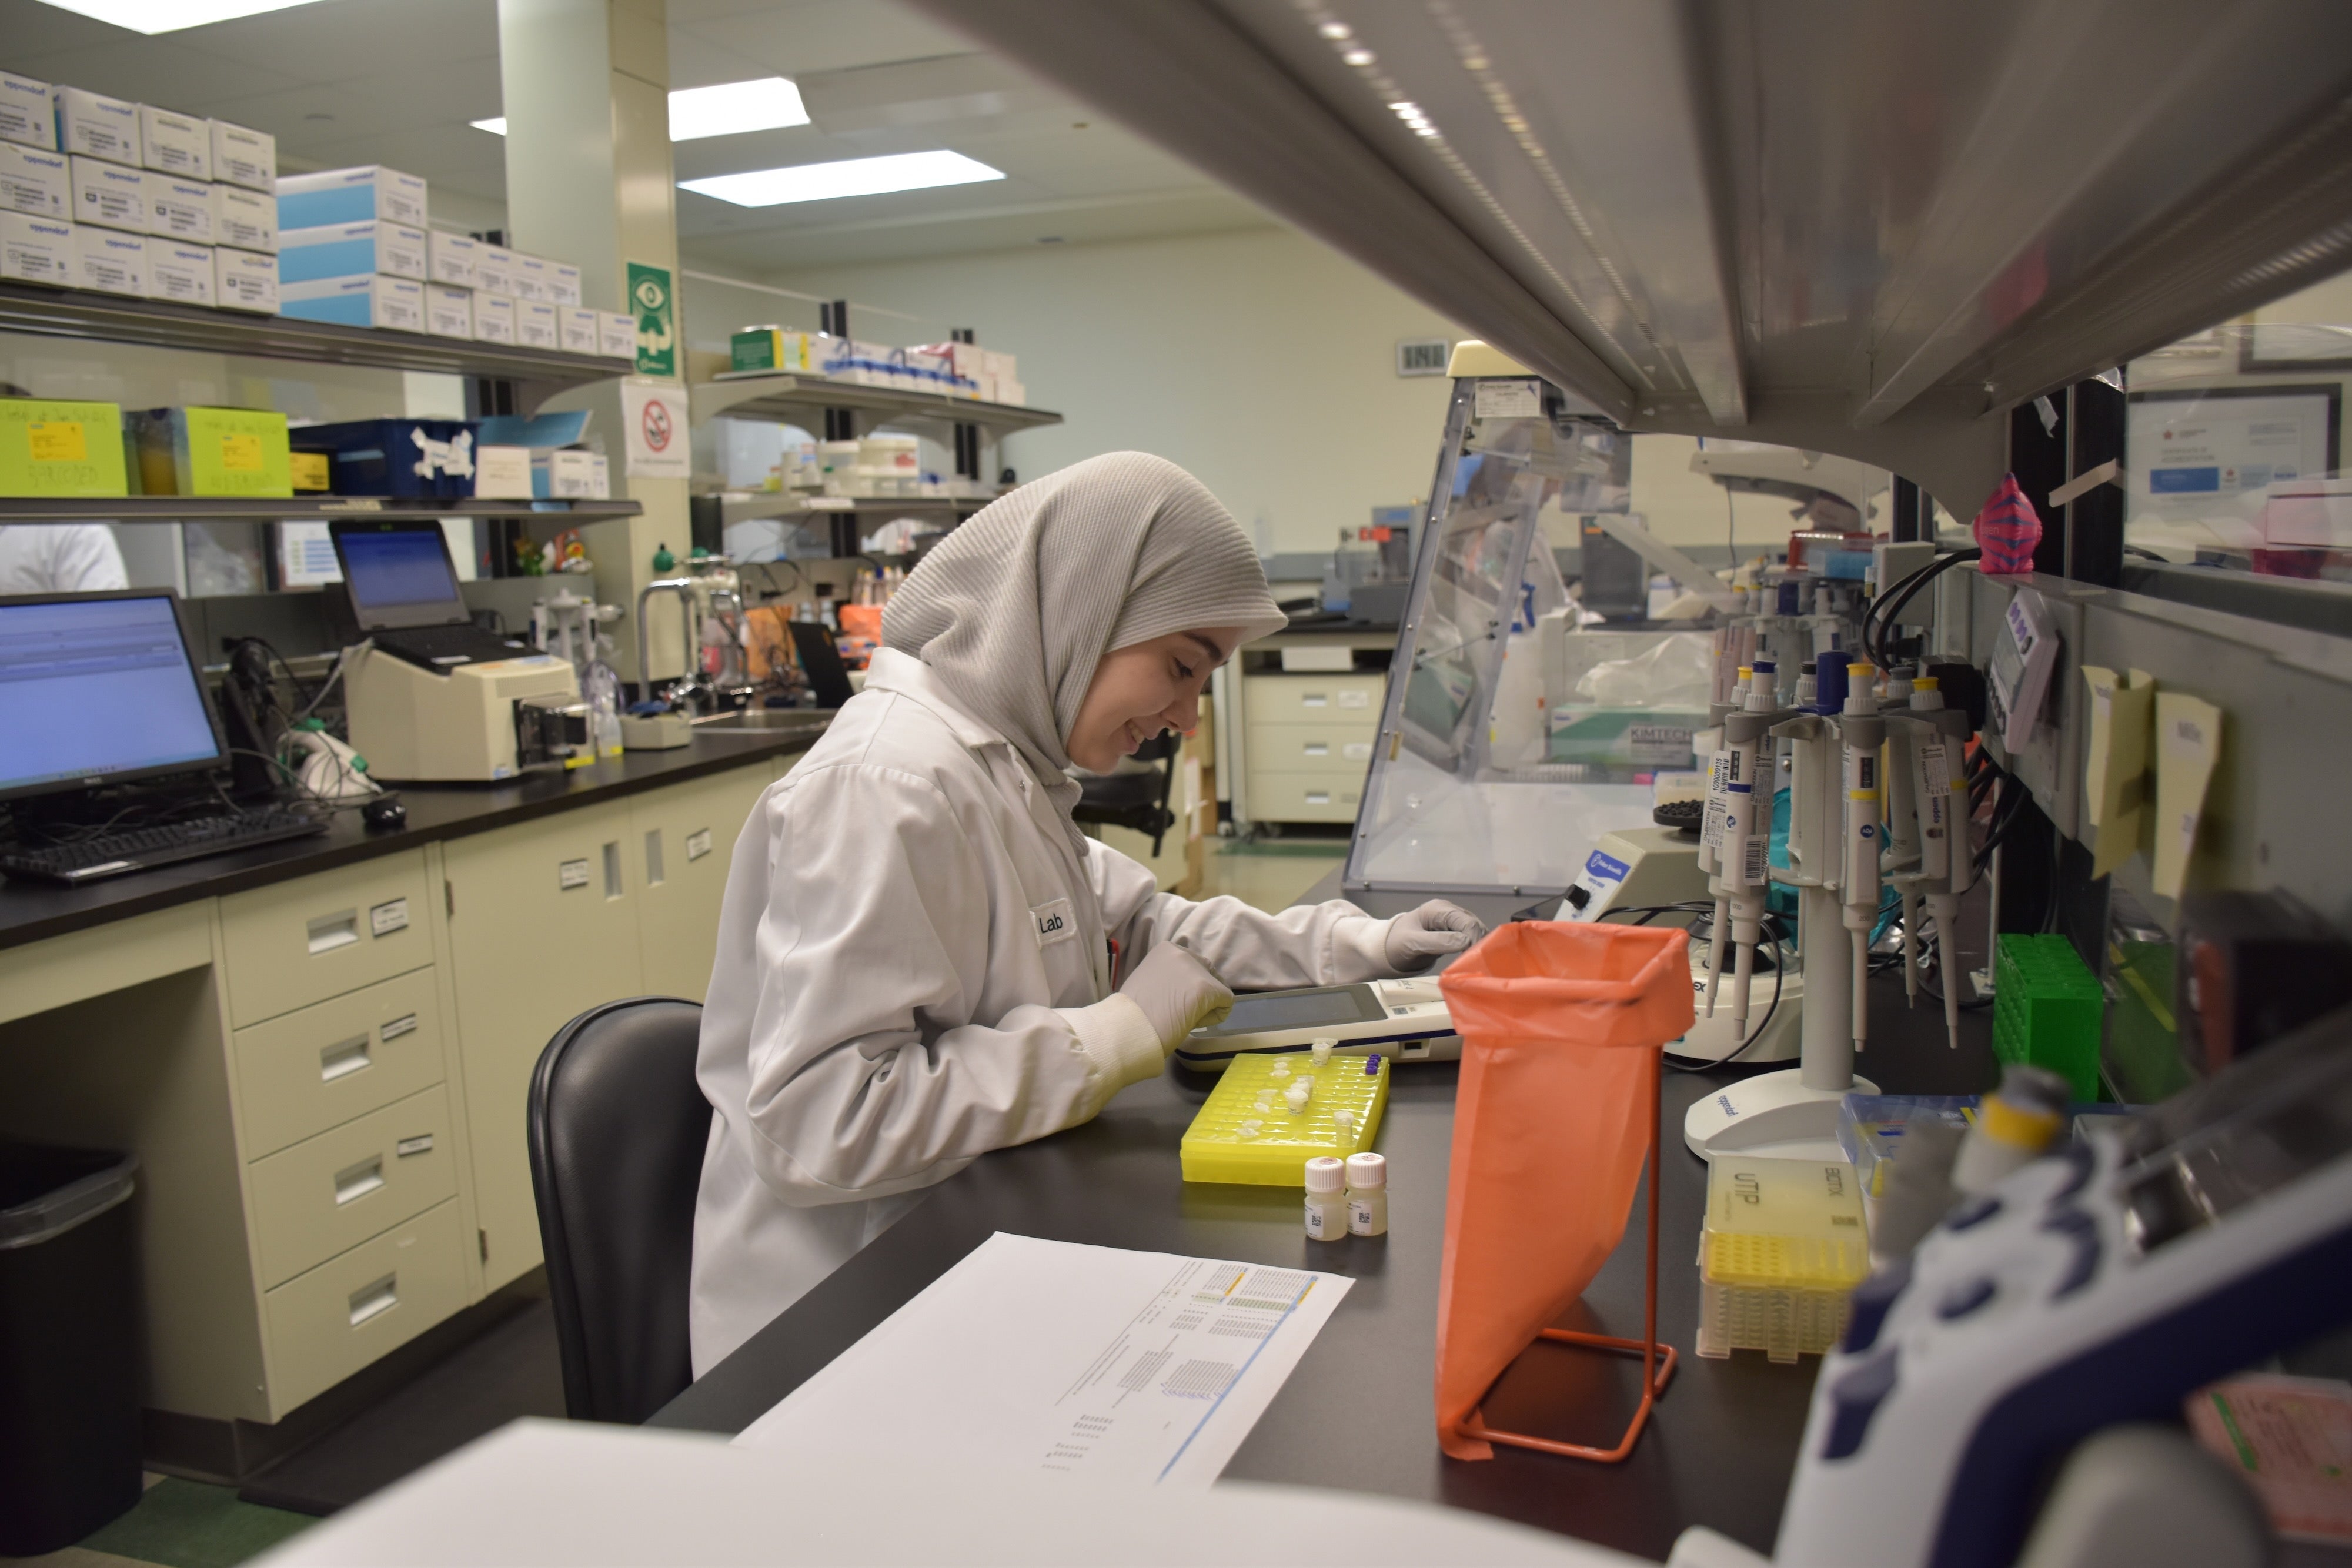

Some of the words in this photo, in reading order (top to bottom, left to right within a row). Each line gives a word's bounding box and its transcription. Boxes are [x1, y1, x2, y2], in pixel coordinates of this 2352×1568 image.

[1631, 728, 1693, 740] KIMTECH
[1712, 758, 1722, 791] 1000000135
[1932, 797, 1941, 823] eppen
[1039, 913, 1063, 934] Lab
[1717, 1095, 1739, 1117] eppendorf
